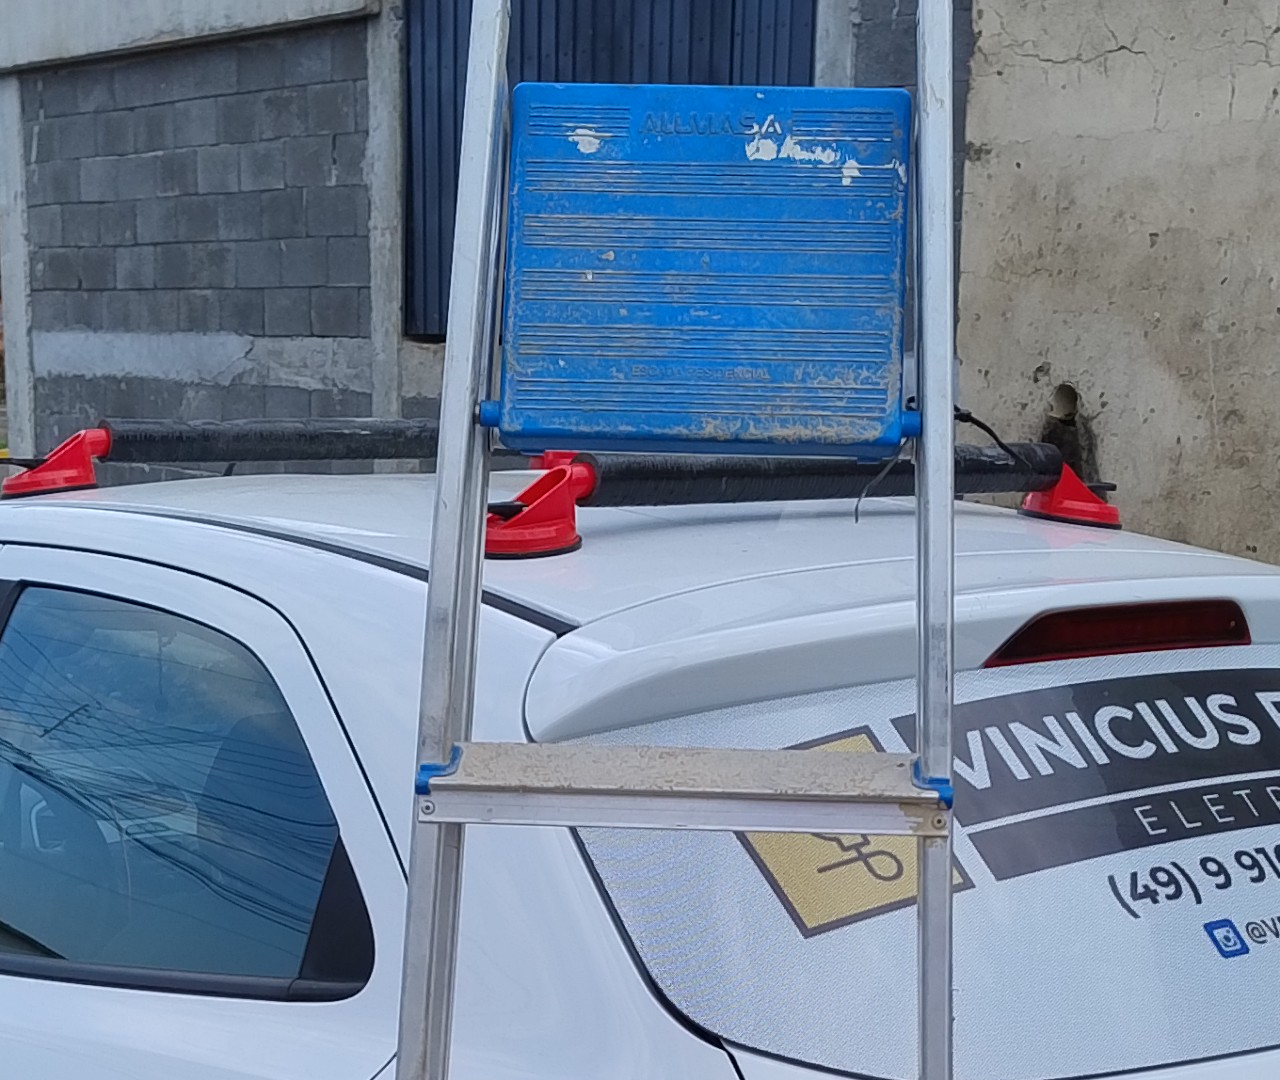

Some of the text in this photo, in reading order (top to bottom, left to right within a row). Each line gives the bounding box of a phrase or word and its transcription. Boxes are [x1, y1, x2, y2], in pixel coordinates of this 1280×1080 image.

[953, 692, 1261, 790] VINICIUS
[1108, 861, 1202, 919] (49)
[1199, 856, 1232, 889] 9
